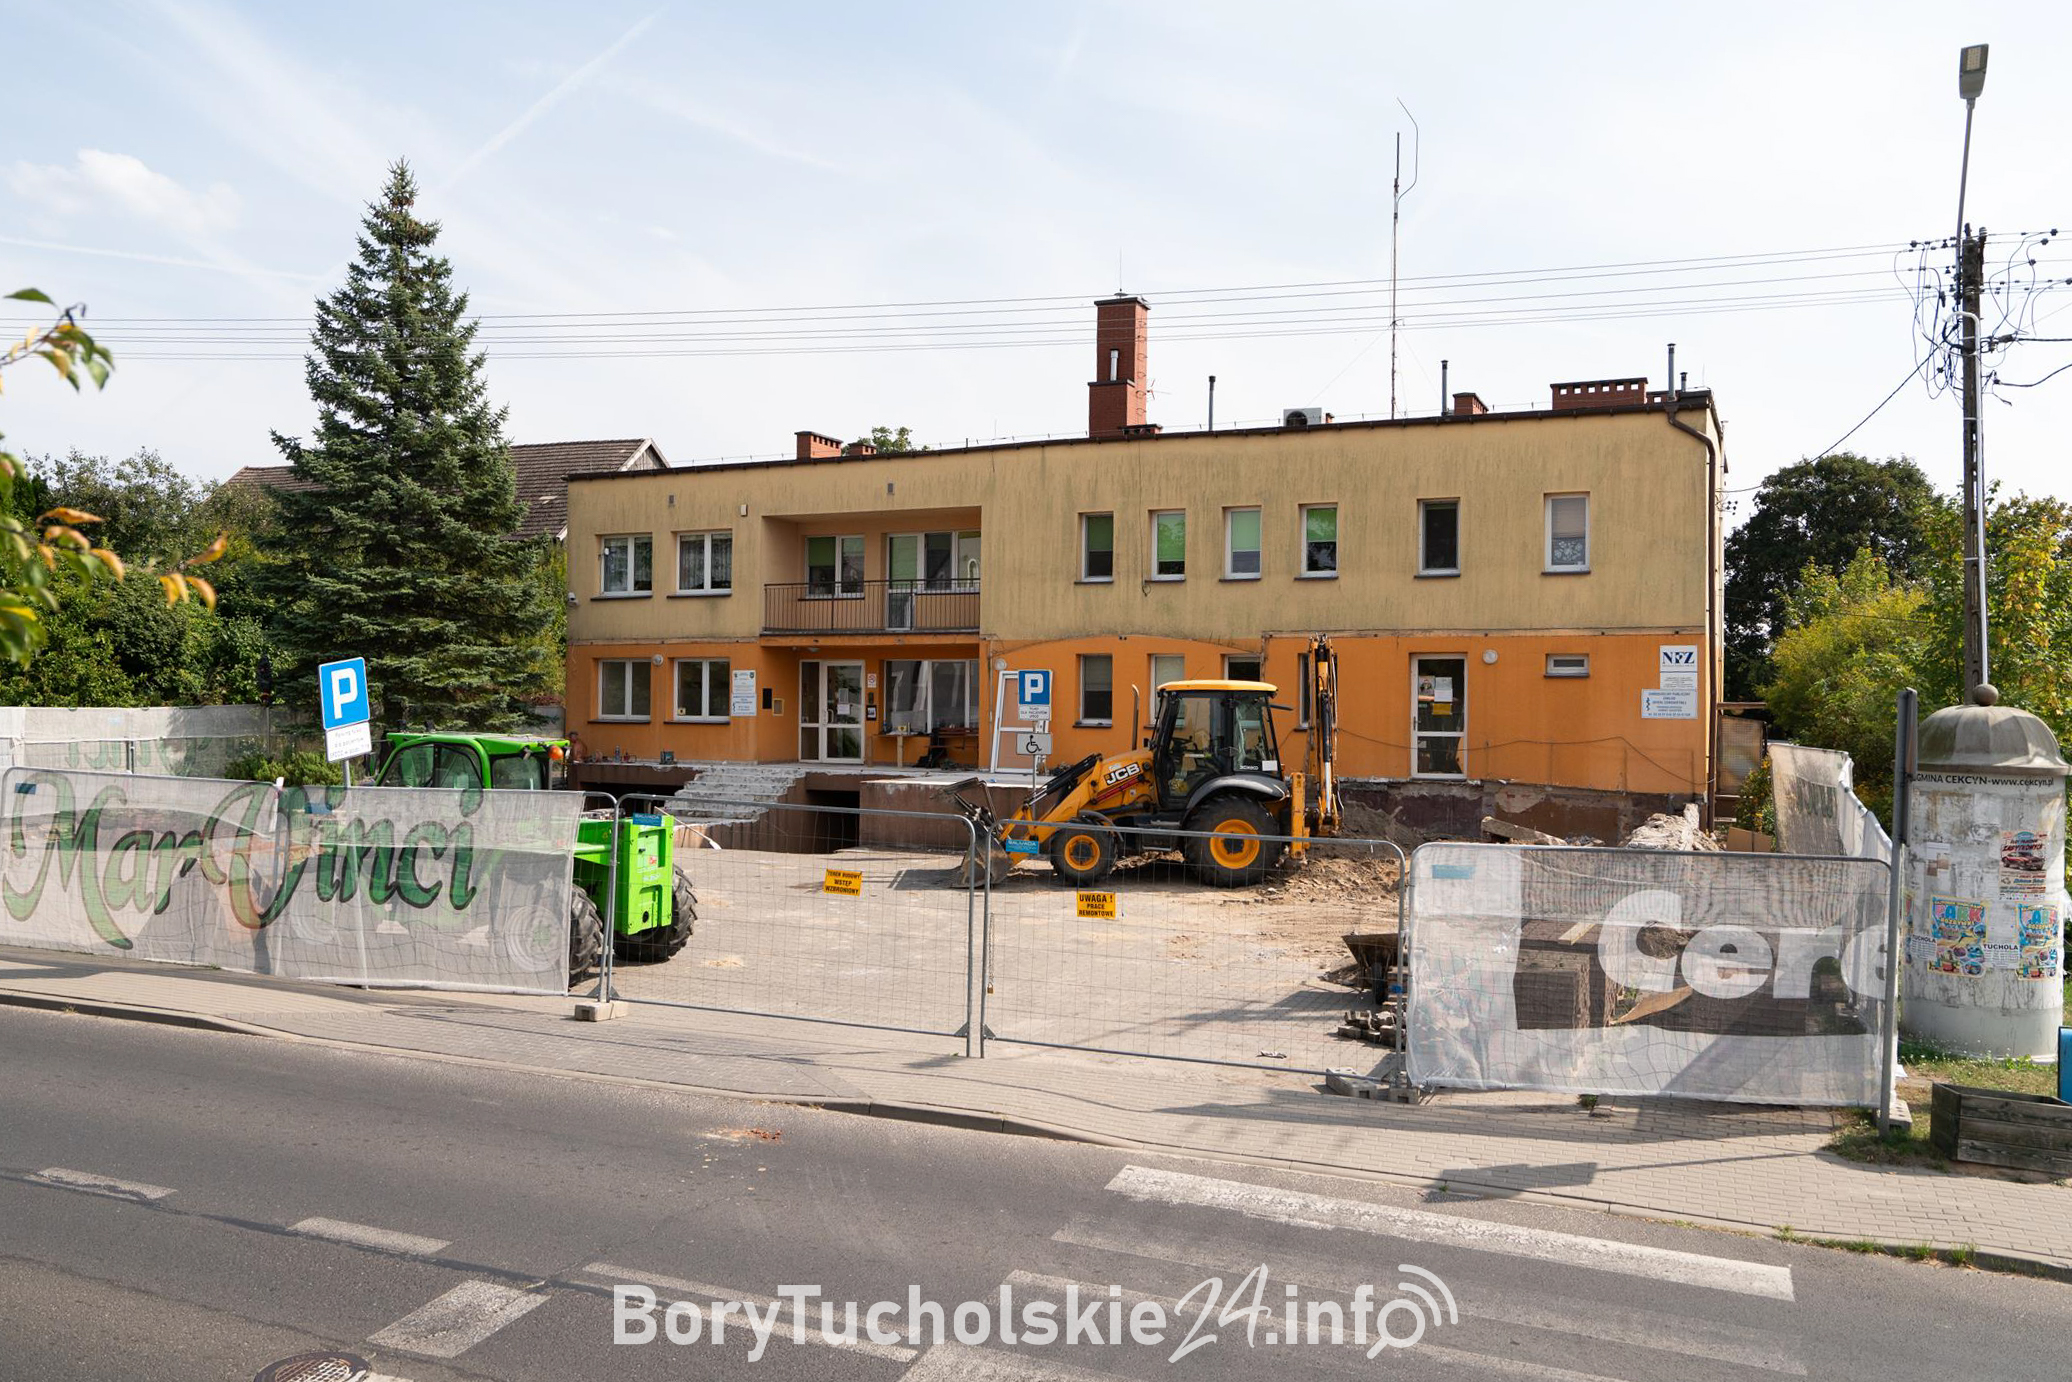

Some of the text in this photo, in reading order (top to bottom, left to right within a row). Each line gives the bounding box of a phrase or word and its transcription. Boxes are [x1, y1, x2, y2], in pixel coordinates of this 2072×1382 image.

[1662, 651, 1695, 665] NFZ
[331, 667, 358, 720] P
[1024, 673, 1044, 702] P
[1106, 763, 1140, 785] JCB
[1915, 773, 1944, 784] GMINA
[1080, 894, 1107, 902] UWAGA
[1983, 943, 2019, 951] TUCHOLA
